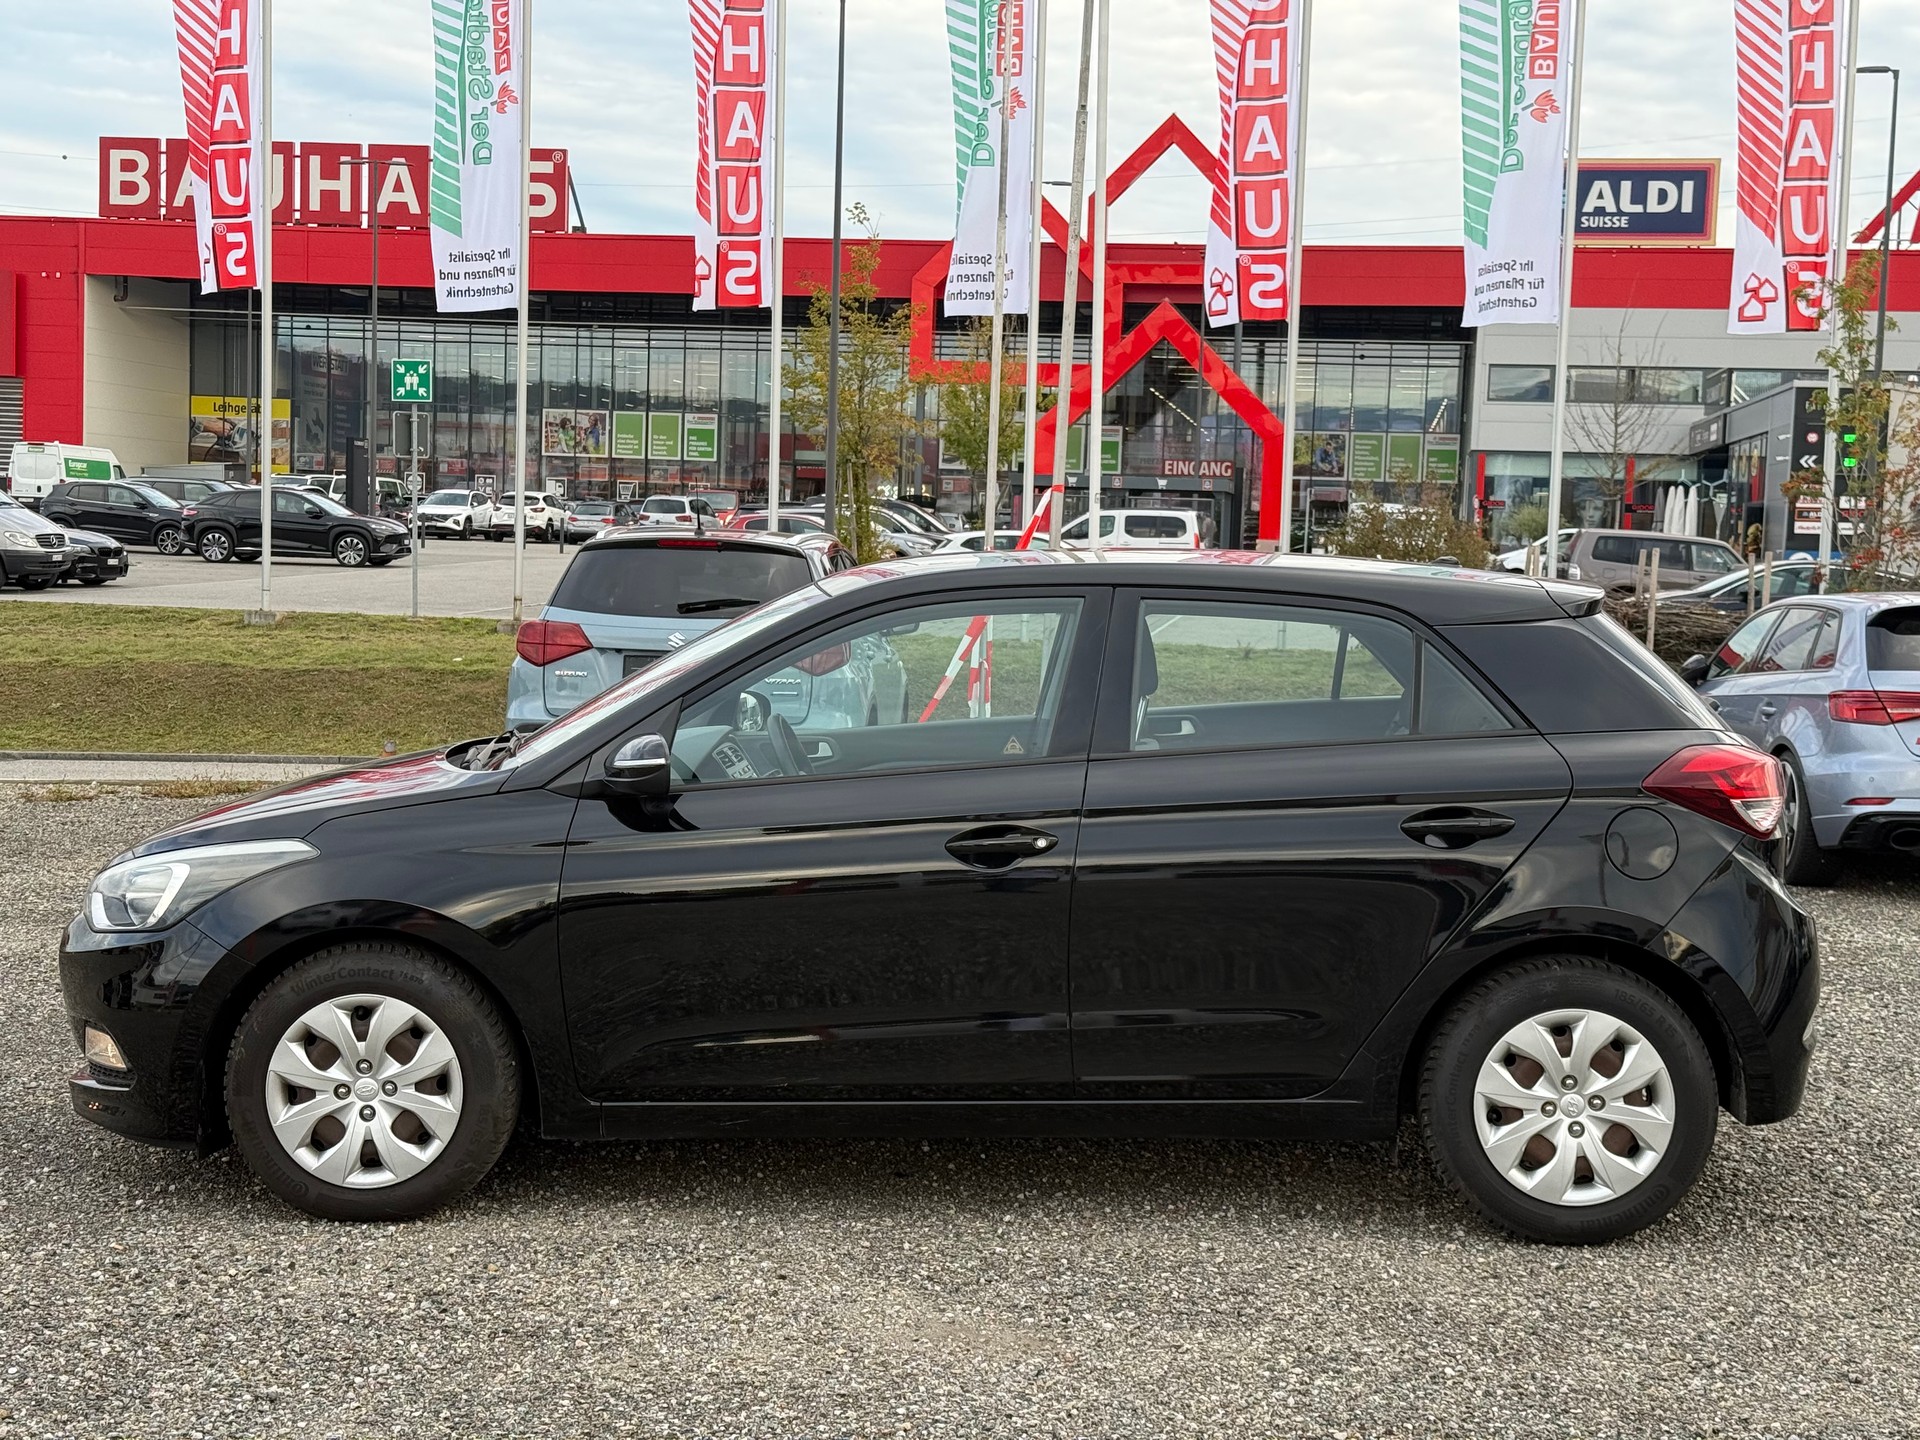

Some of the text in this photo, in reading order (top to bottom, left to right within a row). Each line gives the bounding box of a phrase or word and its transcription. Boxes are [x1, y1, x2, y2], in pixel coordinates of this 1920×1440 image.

[1582, 180, 1695, 213] ALDI
[1580, 216, 1629, 228] SUISSE
[213, 401, 262, 415] Leihgeät
[555, 670, 588, 678] SUZUKI
[290, 966, 395, 995] WinterContact
